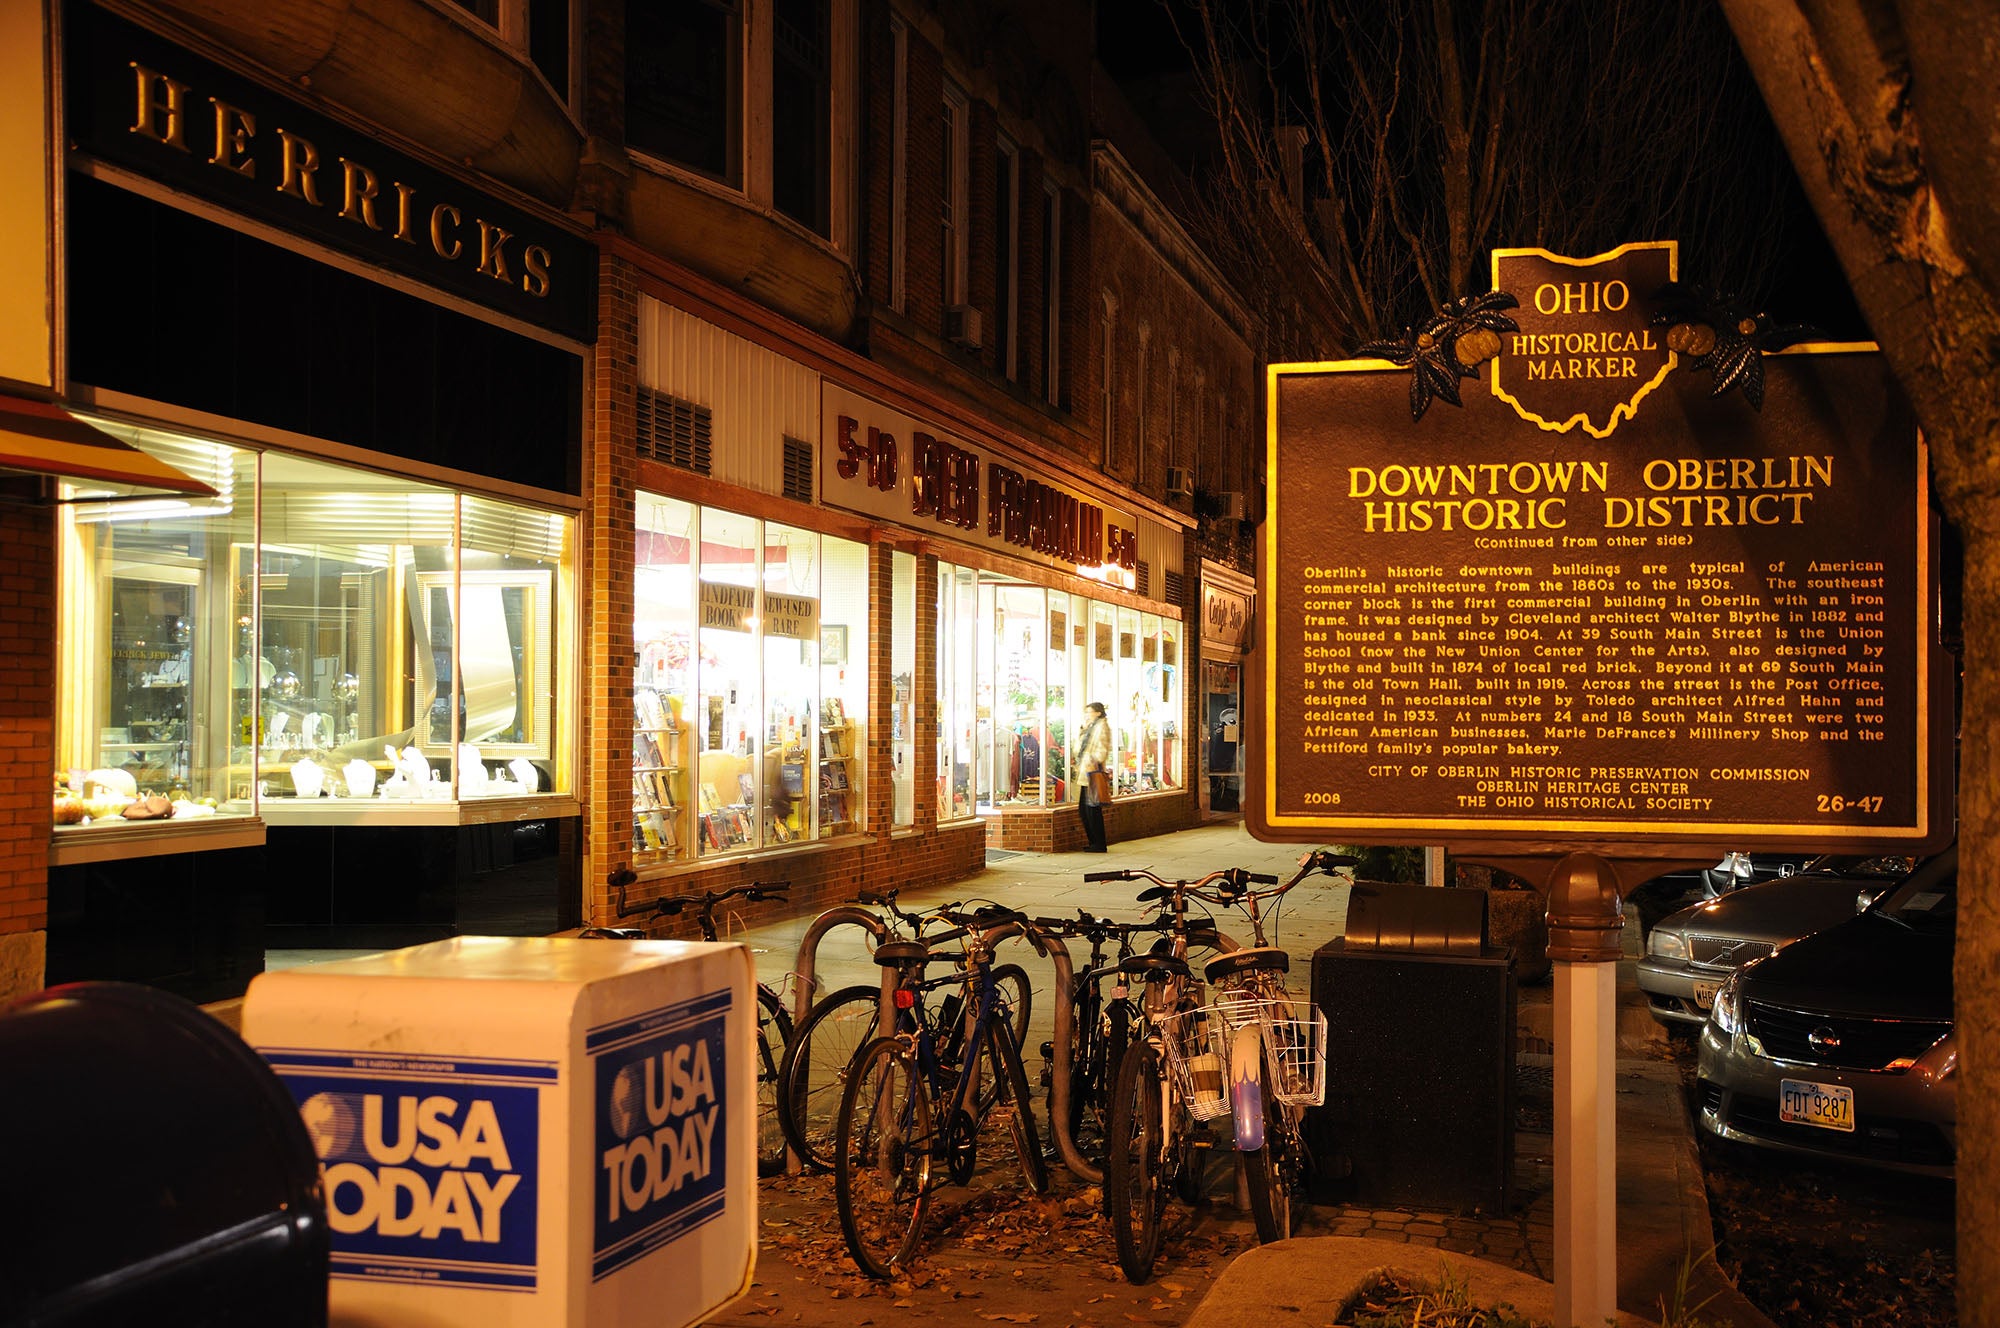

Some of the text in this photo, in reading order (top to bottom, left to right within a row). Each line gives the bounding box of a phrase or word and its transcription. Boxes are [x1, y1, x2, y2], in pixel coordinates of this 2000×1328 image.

[129, 61, 552, 298] HERRICKS
[1534, 279, 1630, 315] OHIO
[1511, 329, 1657, 356] HISTORICAL
[1527, 356, 1638, 381] MARKER
[1347, 455, 1835, 498] DOWNTOWN OBERLIN
[837, 415, 897, 492] 5-10
[913, 431, 979, 531] BEN
[988, 462, 1103, 568] FRANKLIN
[1363, 492, 1814, 533] HISTORIC DISTRICT
[1473, 533, 1694, 549] (Continued from other side)
[1303, 559, 1884, 579] Oberlin's historic downtown buildings are typical of American
[1303, 577, 1885, 595] commercial architecture from the 1860s to the 1930s. The southeast
[1303, 593, 1884, 611] corner block is the first commercial building in Oberlin with an iron
[705, 605, 744, 628] BOOKS
[1303, 610, 1884, 628] frame. It was designed by Cleveland architect Walter Blythe in 1882 and
[773, 617, 799, 636] RARE
[1303, 627, 1884, 642] has housed a bank since 1904. At 39 South Main Street is the Union
[1303, 645, 1351, 659] School
[1360, 645, 1395, 658] (now
[1402, 646, 1427, 658] the
[1435, 645, 1466, 657] New
[1479, 645, 1521, 657] Union
[1533, 645, 1584, 657] Center
[1596, 644, 1619, 657] for
[1630, 644, 1656, 657] the
[1729, 644, 1761, 656] also
[1775, 643, 1847, 658] designed
[1863, 643, 1884, 658] by
[1303, 693, 1884, 709] designed in neoclassical style by Toledo architect Alfred Hahn and
[1303, 709, 1884, 724] dedicated in 1933. At numbers 24 and 18 South Main Street were two
[1303, 725, 1359, 737] African
[1369, 725, 1439, 738] American
[1544, 726, 1587, 739] Marie
[1596, 726, 1677, 739] DeFrance's
[1689, 727, 1761, 741] Millinery
[1771, 727, 1809, 743] Shop
[1819, 729, 1849, 741] and
[1857, 729, 1885, 741] the
[1303, 741, 1562, 757] Pettiford family's popular bakery.
[1368, 765, 1810, 781] CITY OF OBERLIN HISTORIC PRESERVATION COMMISSION
[1476, 780, 1689, 795] OBERLIN HERITAGE CENTER
[1303, 792, 1341, 805] 2008
[1456, 795, 1713, 811] THE OHIO HISTORICAL SOCIETY
[644, 1039, 716, 1127] USA
[1785, 1091, 1848, 1120] FDT 9287
[362, 1094, 512, 1171] USA
[603, 1104, 720, 1223] TODAY
[320, 1162, 521, 1243] ODAY
